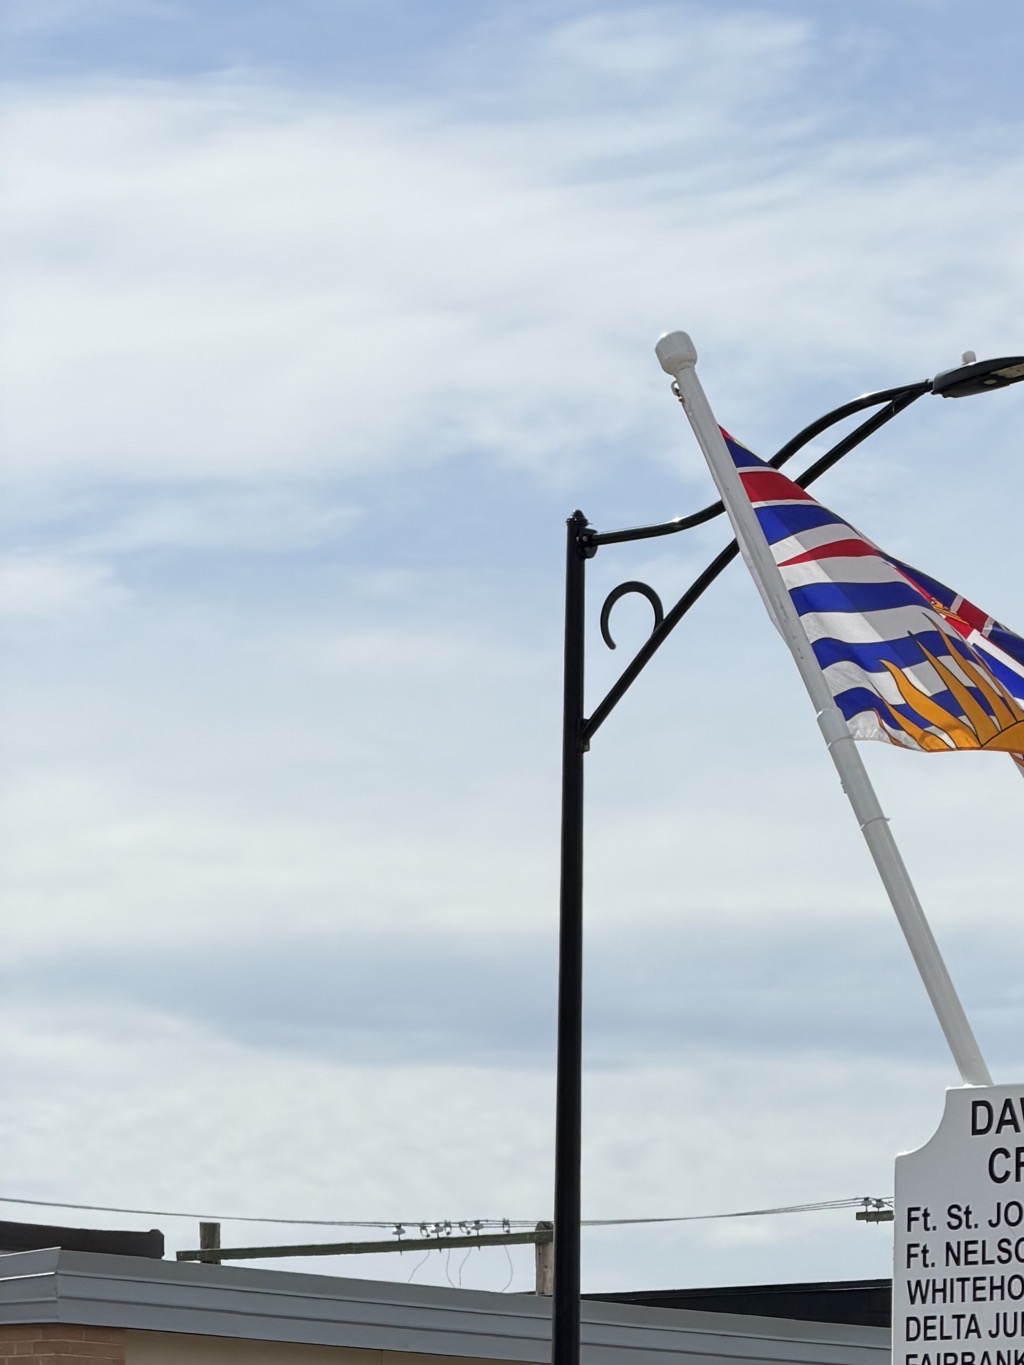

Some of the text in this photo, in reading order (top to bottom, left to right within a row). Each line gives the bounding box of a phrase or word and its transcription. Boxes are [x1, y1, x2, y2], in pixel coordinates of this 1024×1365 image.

[907, 1207, 936, 1232] Ft.
[947, 1204, 978, 1230] St.
[907, 1243, 935, 1268] Ft.
[906, 1314, 982, 1341] DELTA
